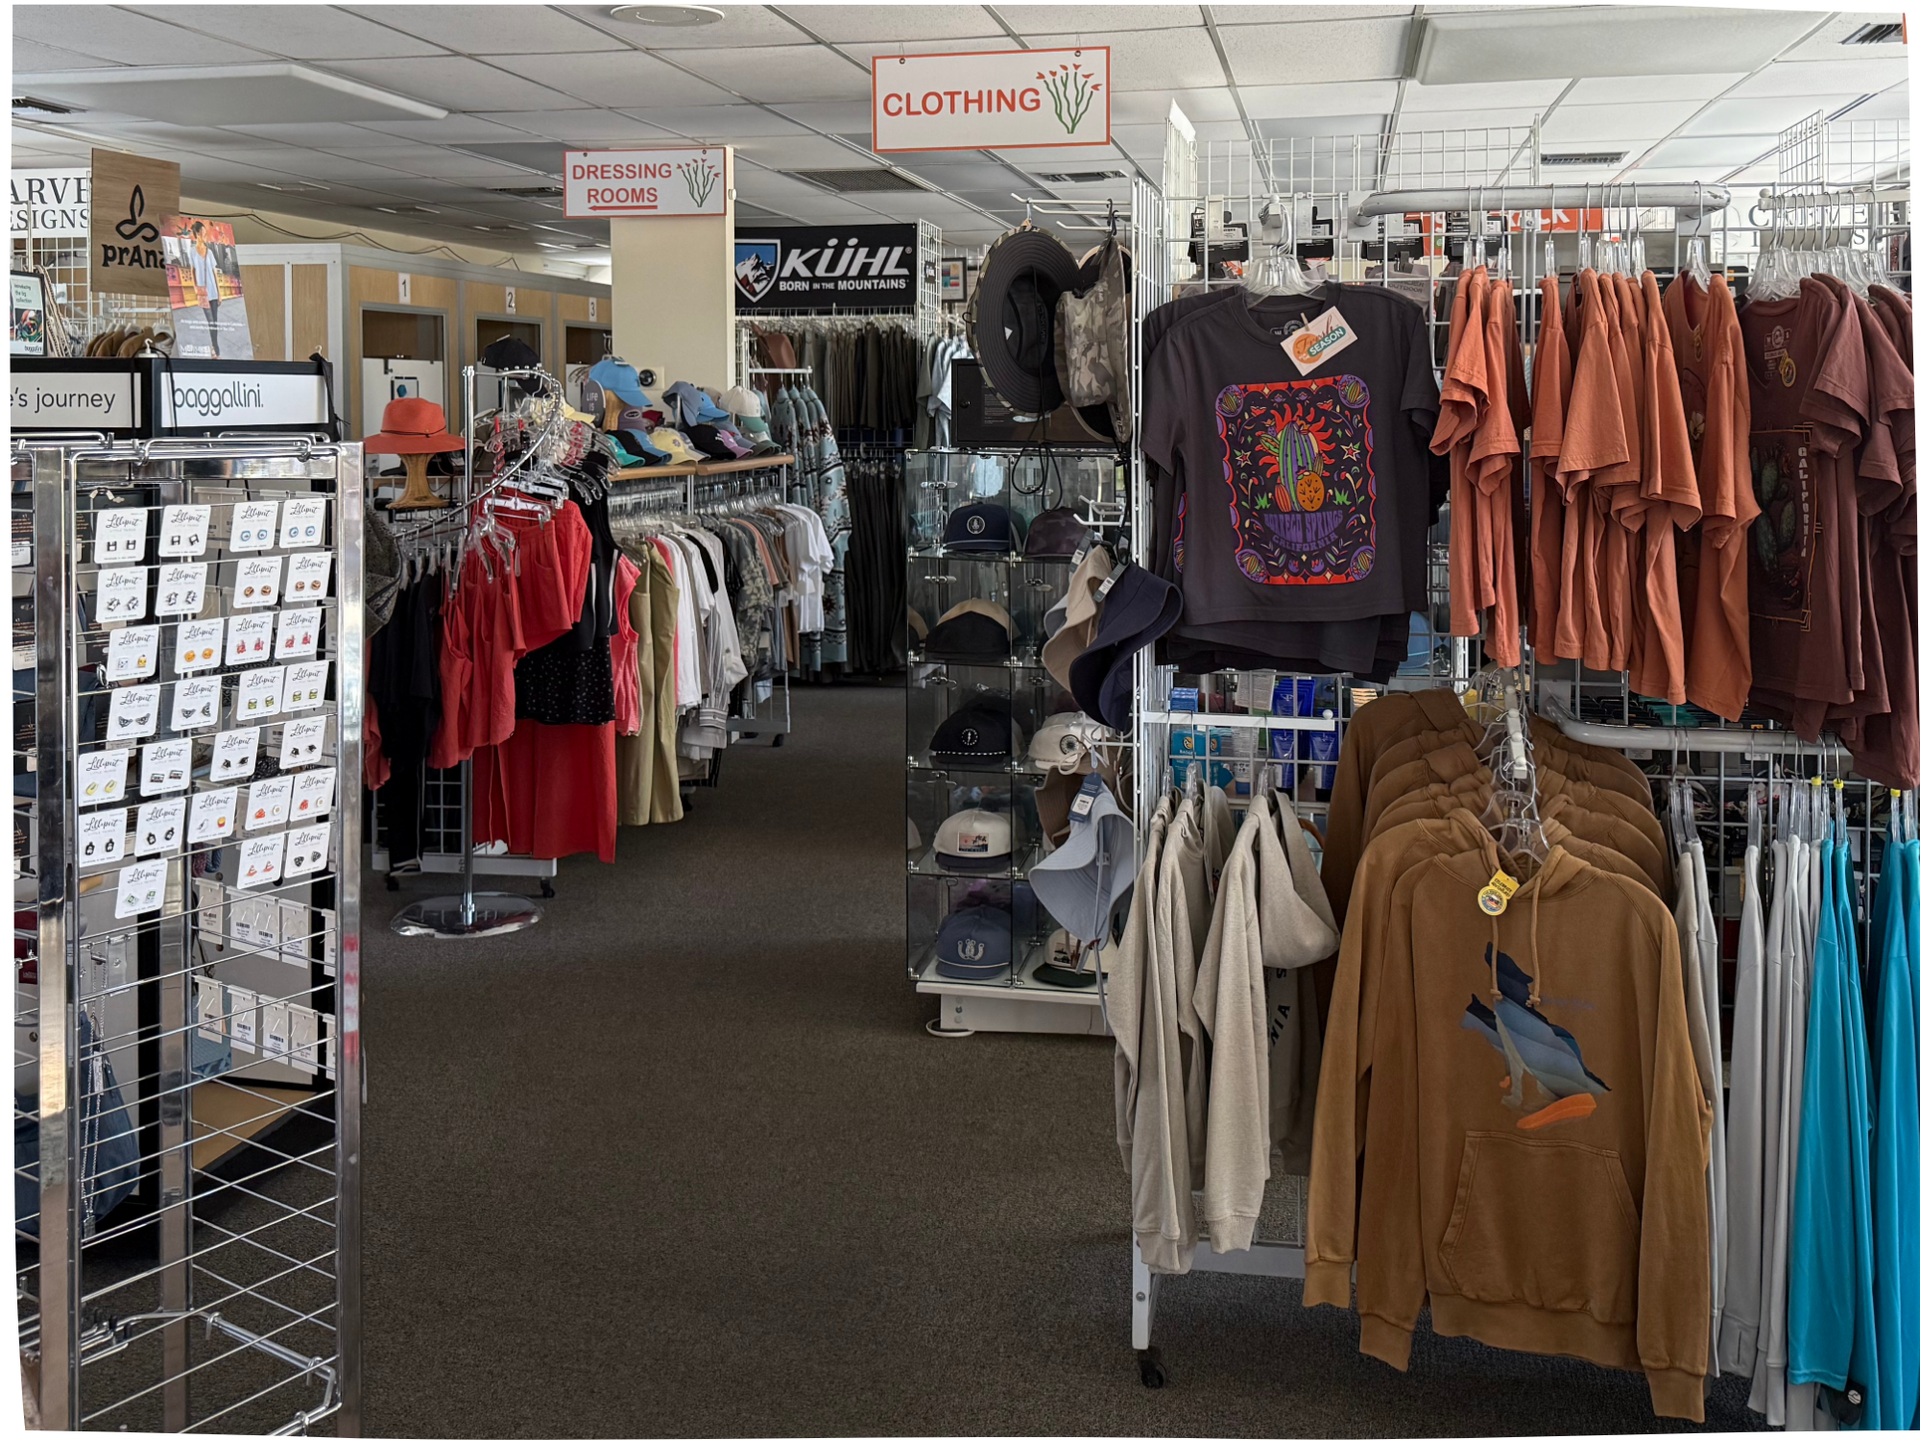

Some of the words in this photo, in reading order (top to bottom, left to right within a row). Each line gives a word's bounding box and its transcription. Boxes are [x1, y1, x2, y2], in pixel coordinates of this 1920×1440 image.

[883, 88, 1041, 116] CLOTHING
[572, 163, 672, 180] DRESSING
[587, 187, 658, 203] ROOMS
[402, 279, 407, 297] 1
[779, 281, 810, 291] BORN
[822, 281, 835, 289] THE
[507, 291, 514, 308] 2
[591, 302, 596, 316] 3
[1309, 328, 1344, 355] SEASON
[34, 388, 116, 414] journey
[1305, 510, 1343, 543] SPRINGS
[1272, 532, 1338, 552] CALIFORNIA
